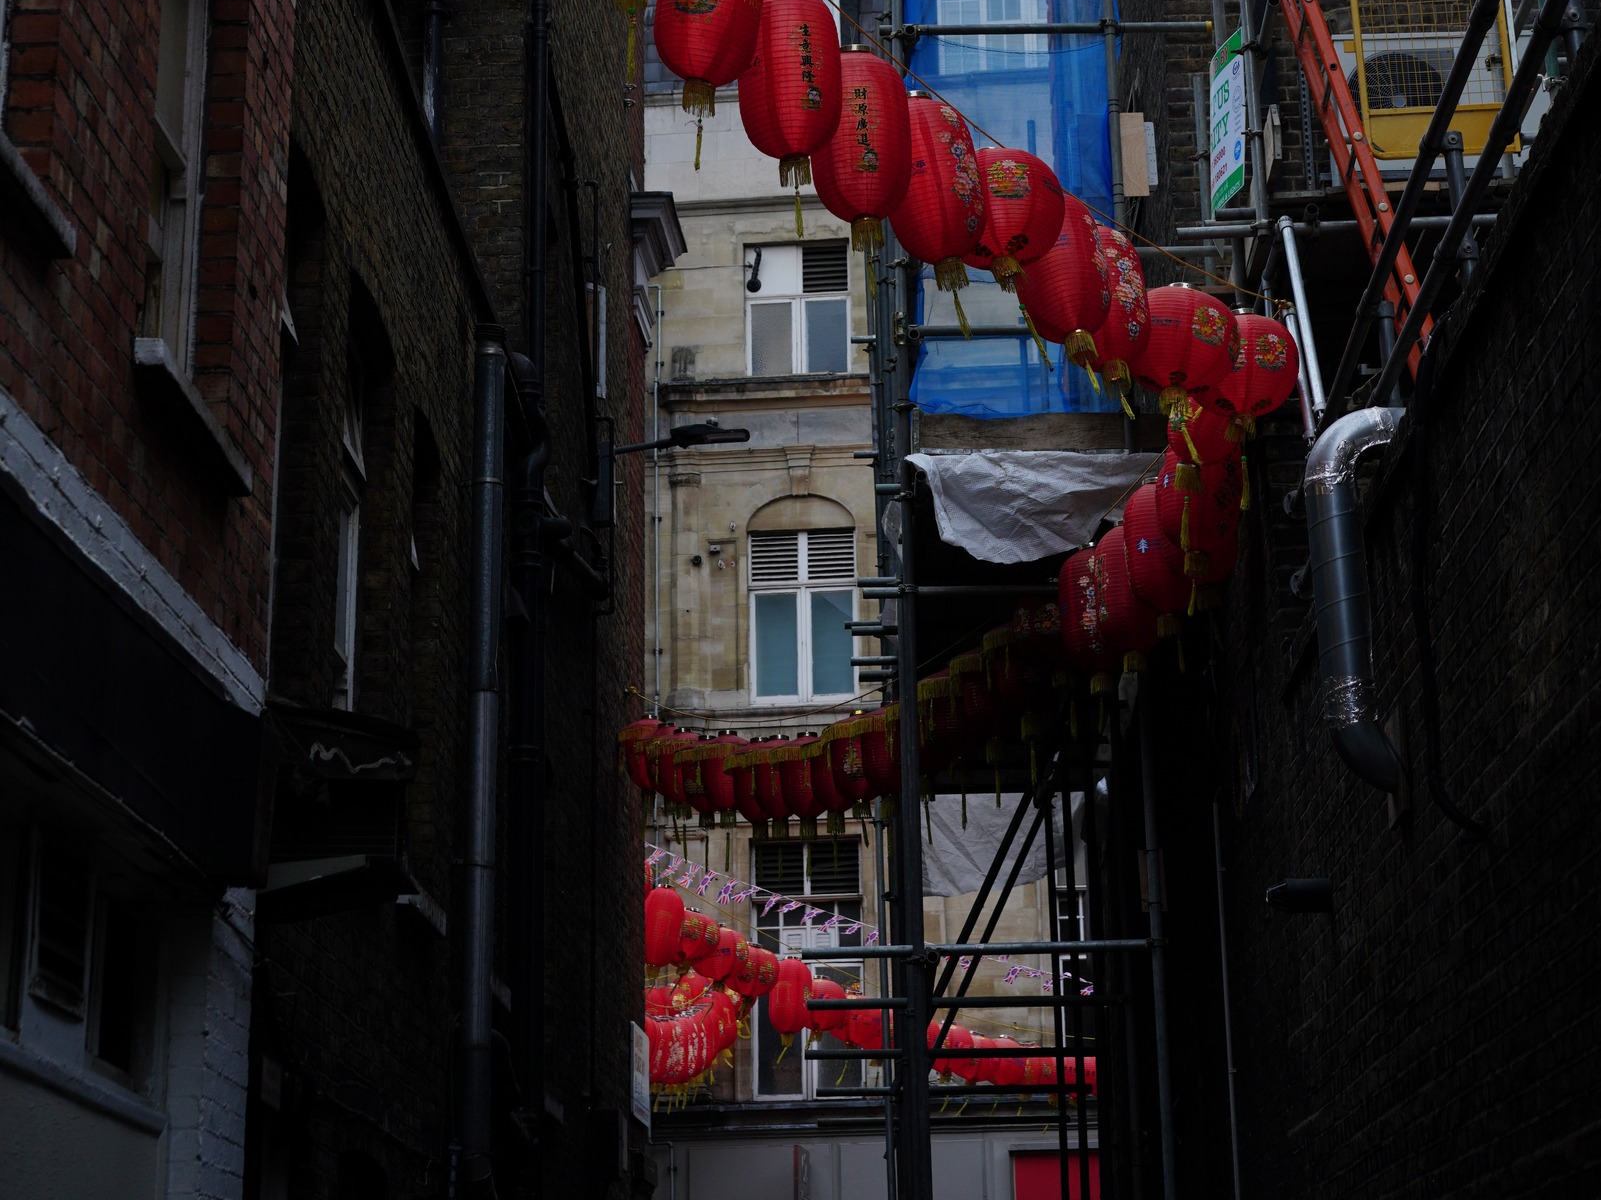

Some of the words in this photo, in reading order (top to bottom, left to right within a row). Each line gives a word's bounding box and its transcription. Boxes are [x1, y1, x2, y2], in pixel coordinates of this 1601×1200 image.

[798, 23, 816, 84] 生意興隆
[1220, 43, 1230, 67] BY
[853, 87, 871, 146] 財源廣進
